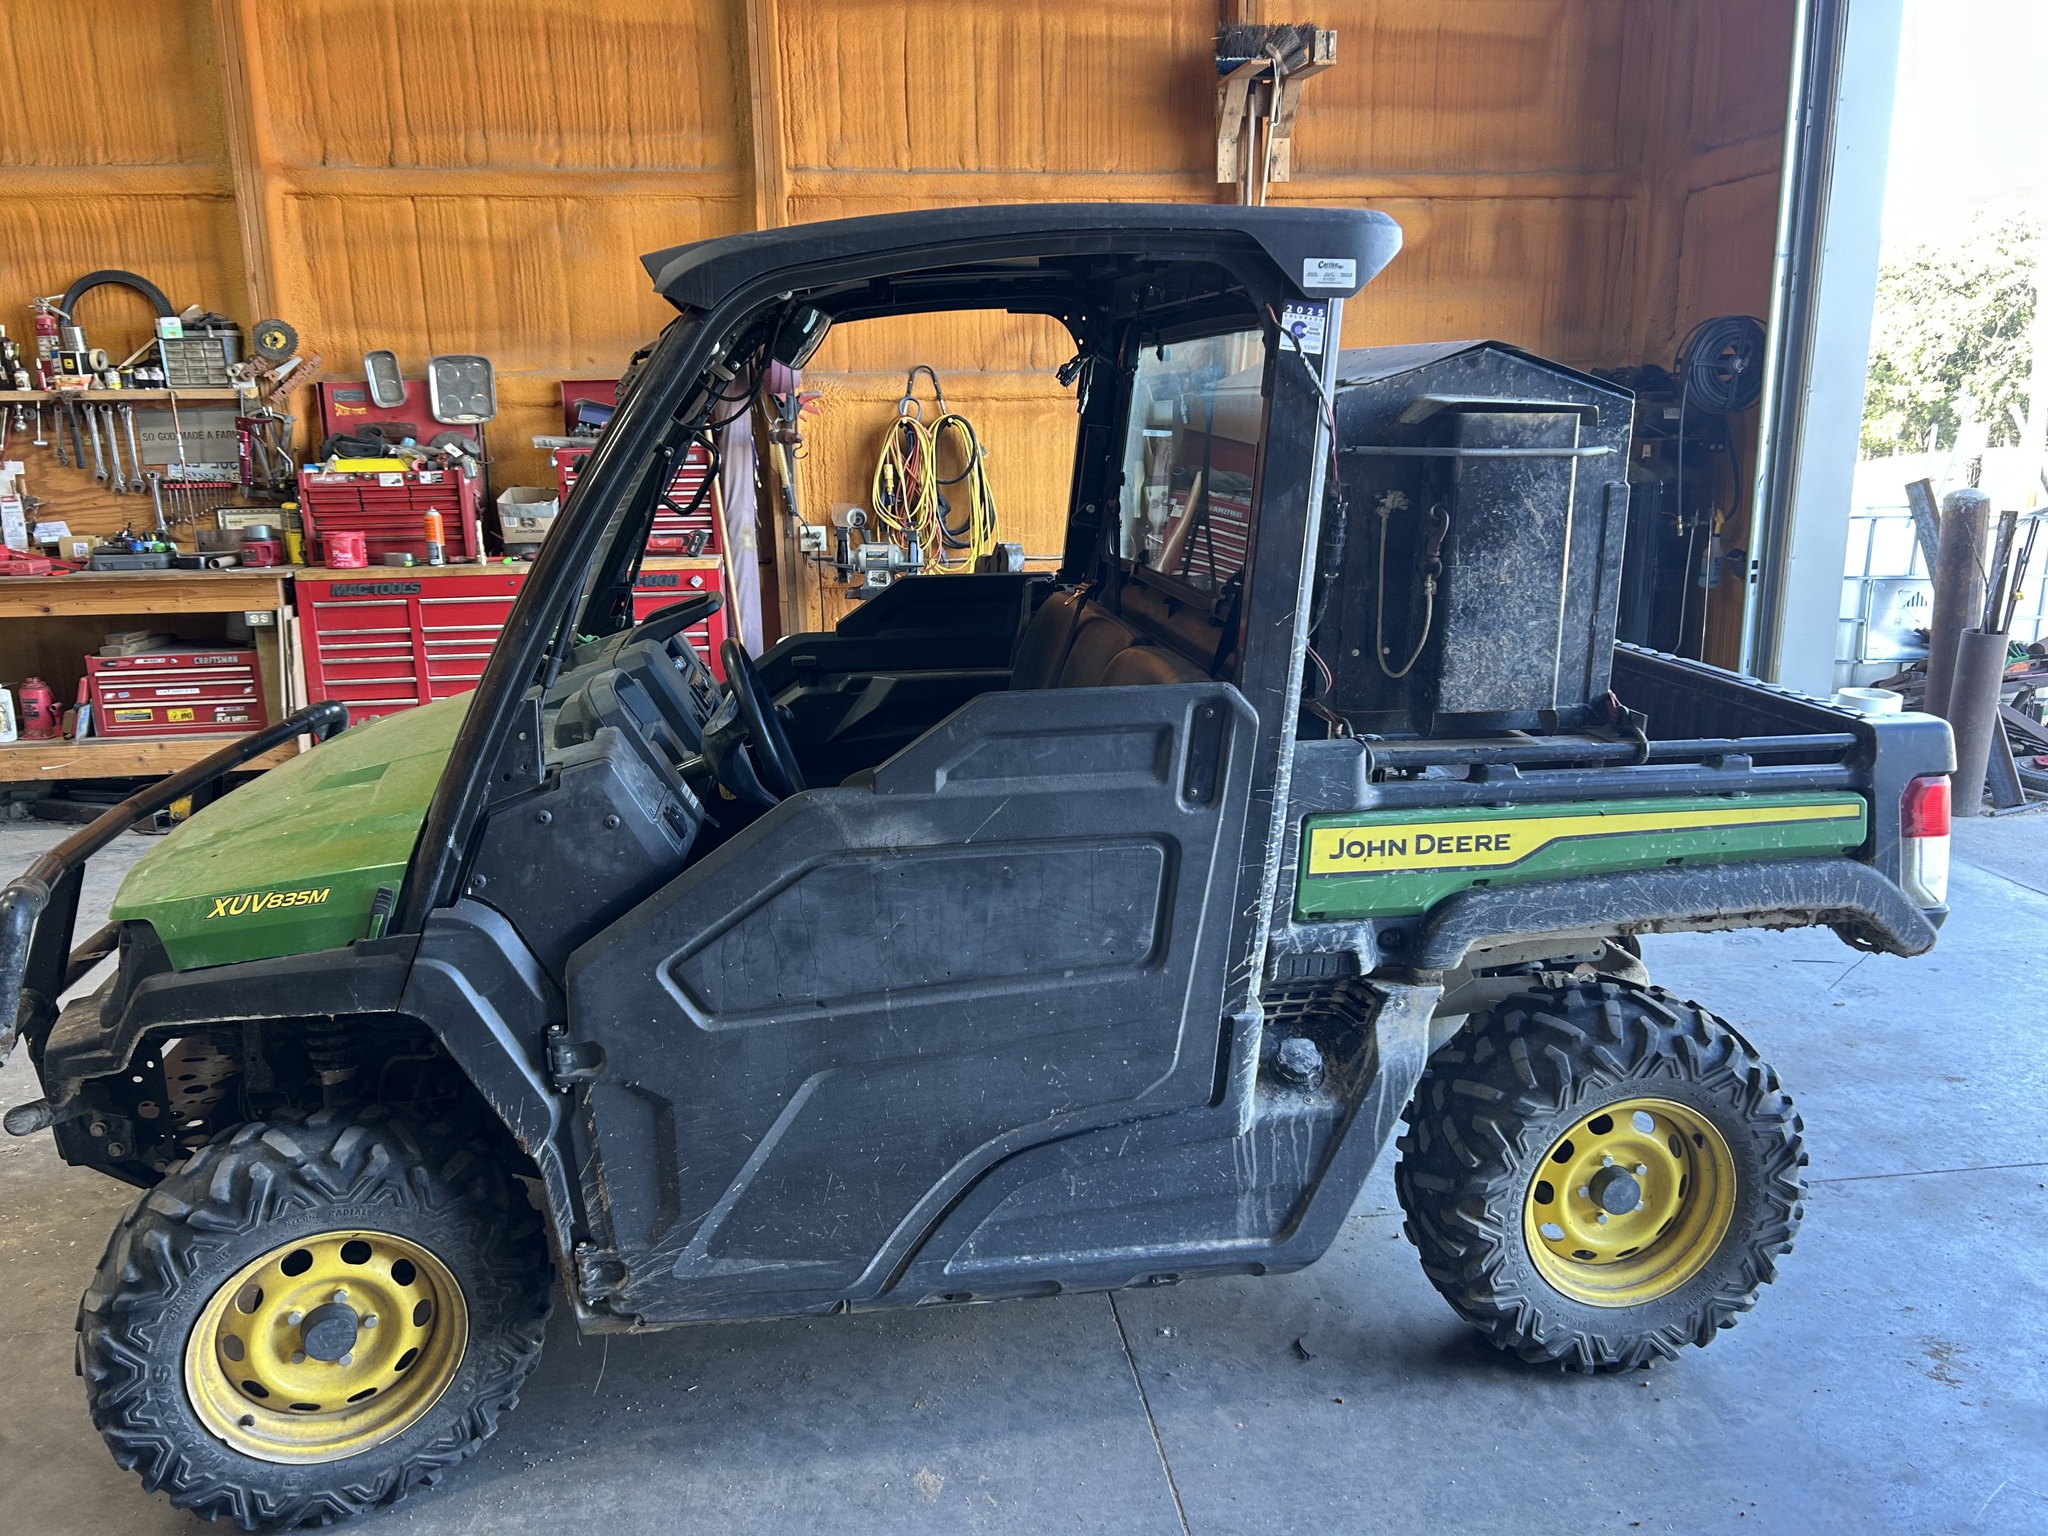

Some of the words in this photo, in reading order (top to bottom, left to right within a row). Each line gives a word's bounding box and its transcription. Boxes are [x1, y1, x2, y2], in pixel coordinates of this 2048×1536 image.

[1286, 304, 1324, 317] 2025
[1284, 314, 1324, 322] COLORADO
[142, 432, 155, 441] SO
[158, 432, 176, 441] GOD
[180, 431, 204, 440] MADE
[207, 430, 214, 440] A
[331, 583, 368, 598] MAC
[372, 581, 421, 596] TOOLS
[194, 655, 239, 665] CRAFTSMAN
[1329, 837, 1407, 860] JOHN
[1415, 833, 1512, 855] DEERE
[203, 886, 332, 920] XUV835M
[328, 1208, 369, 1218] RADIAL
[152, 1363, 225, 1472] MAXXIS
